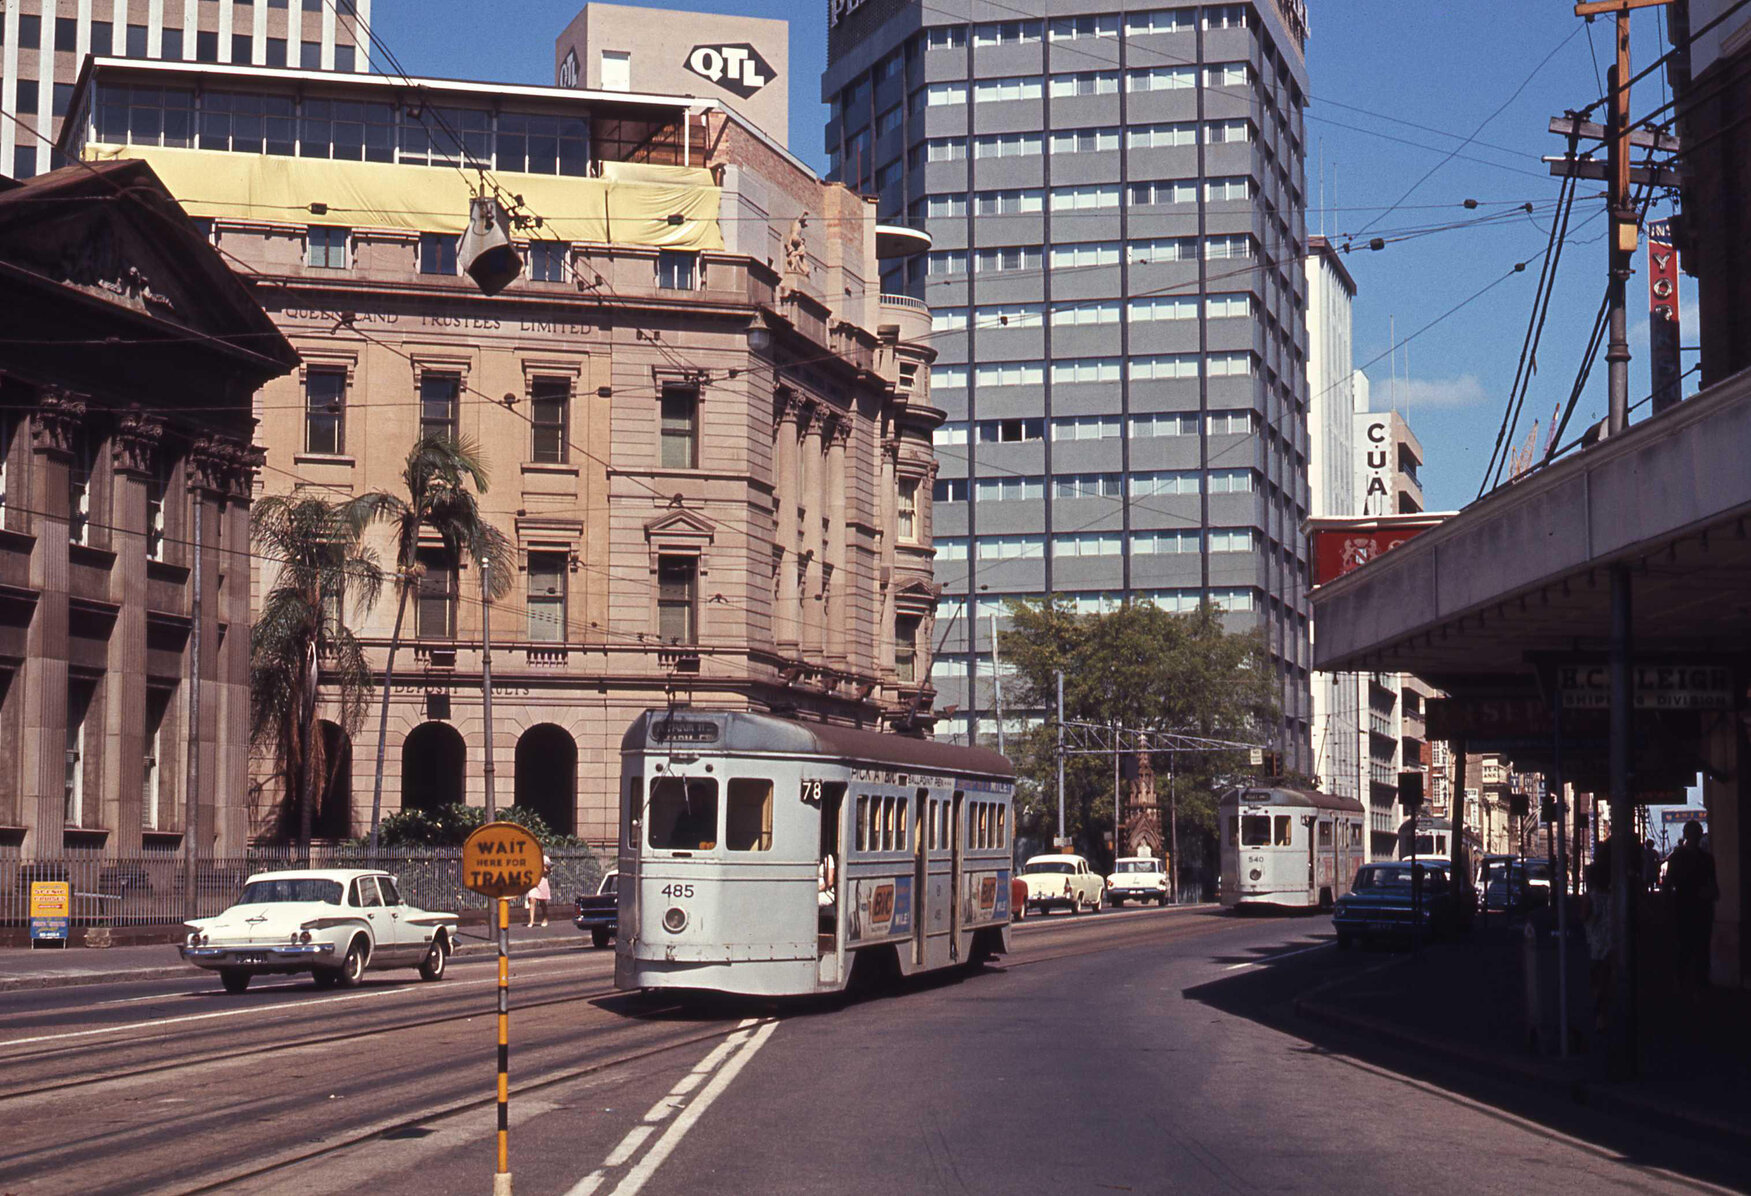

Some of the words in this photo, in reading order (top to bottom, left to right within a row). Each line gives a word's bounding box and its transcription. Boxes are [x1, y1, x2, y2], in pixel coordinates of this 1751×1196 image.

[690, 47, 765, 87] QTL
[286, 307, 398, 324] QUEENLAND
[421, 313, 500, 329] TRUSTEES
[520, 318, 592, 334] LIMITED
[1638, 669, 1727, 691] LEIGH
[1657, 696, 1725, 707] DIVISION
[851, 768, 871, 781] PICK
[802, 782, 822, 800] 78
[477, 841, 526, 855] WAIT
[471, 871, 533, 887] TRAMS
[661, 883, 694, 898] 485
